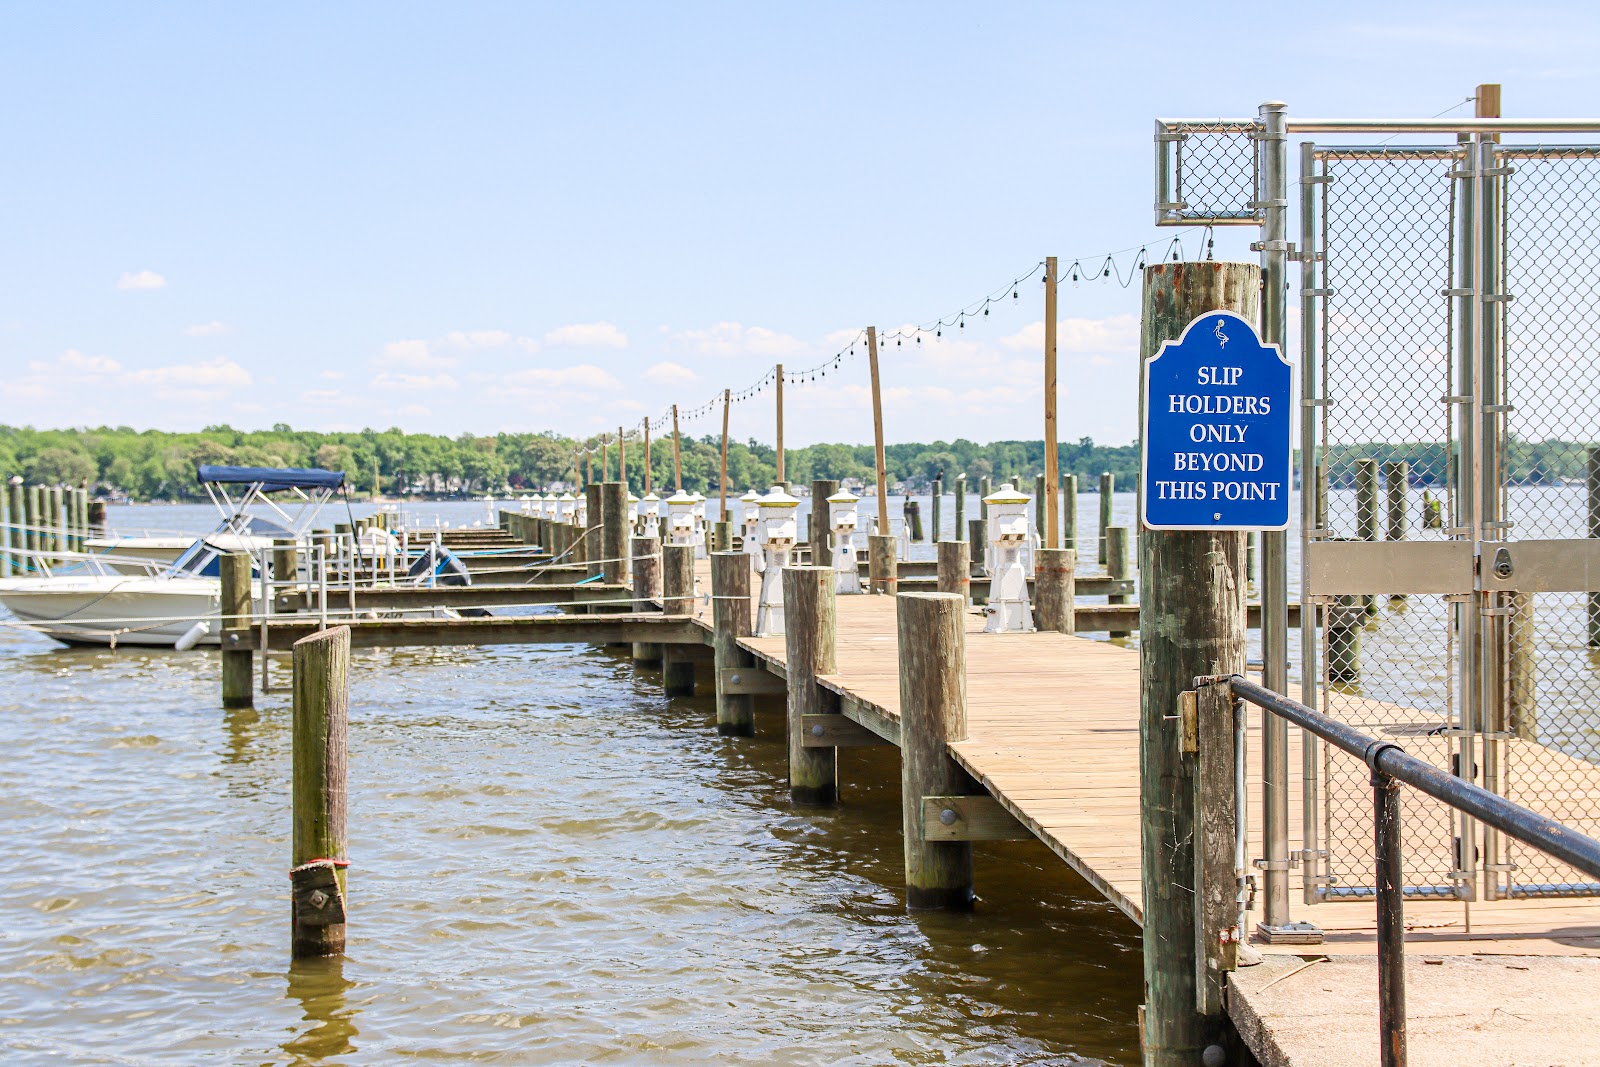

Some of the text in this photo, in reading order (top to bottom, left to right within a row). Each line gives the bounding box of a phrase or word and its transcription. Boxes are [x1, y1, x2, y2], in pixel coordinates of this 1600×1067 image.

[1198, 367, 1243, 385] SLIP
[1168, 395, 1271, 415] HOLDERS
[1190, 424, 1248, 442] ONLY
[1174, 453, 1264, 472] BEYOND
[1156, 481, 1280, 500] THIS POINT
